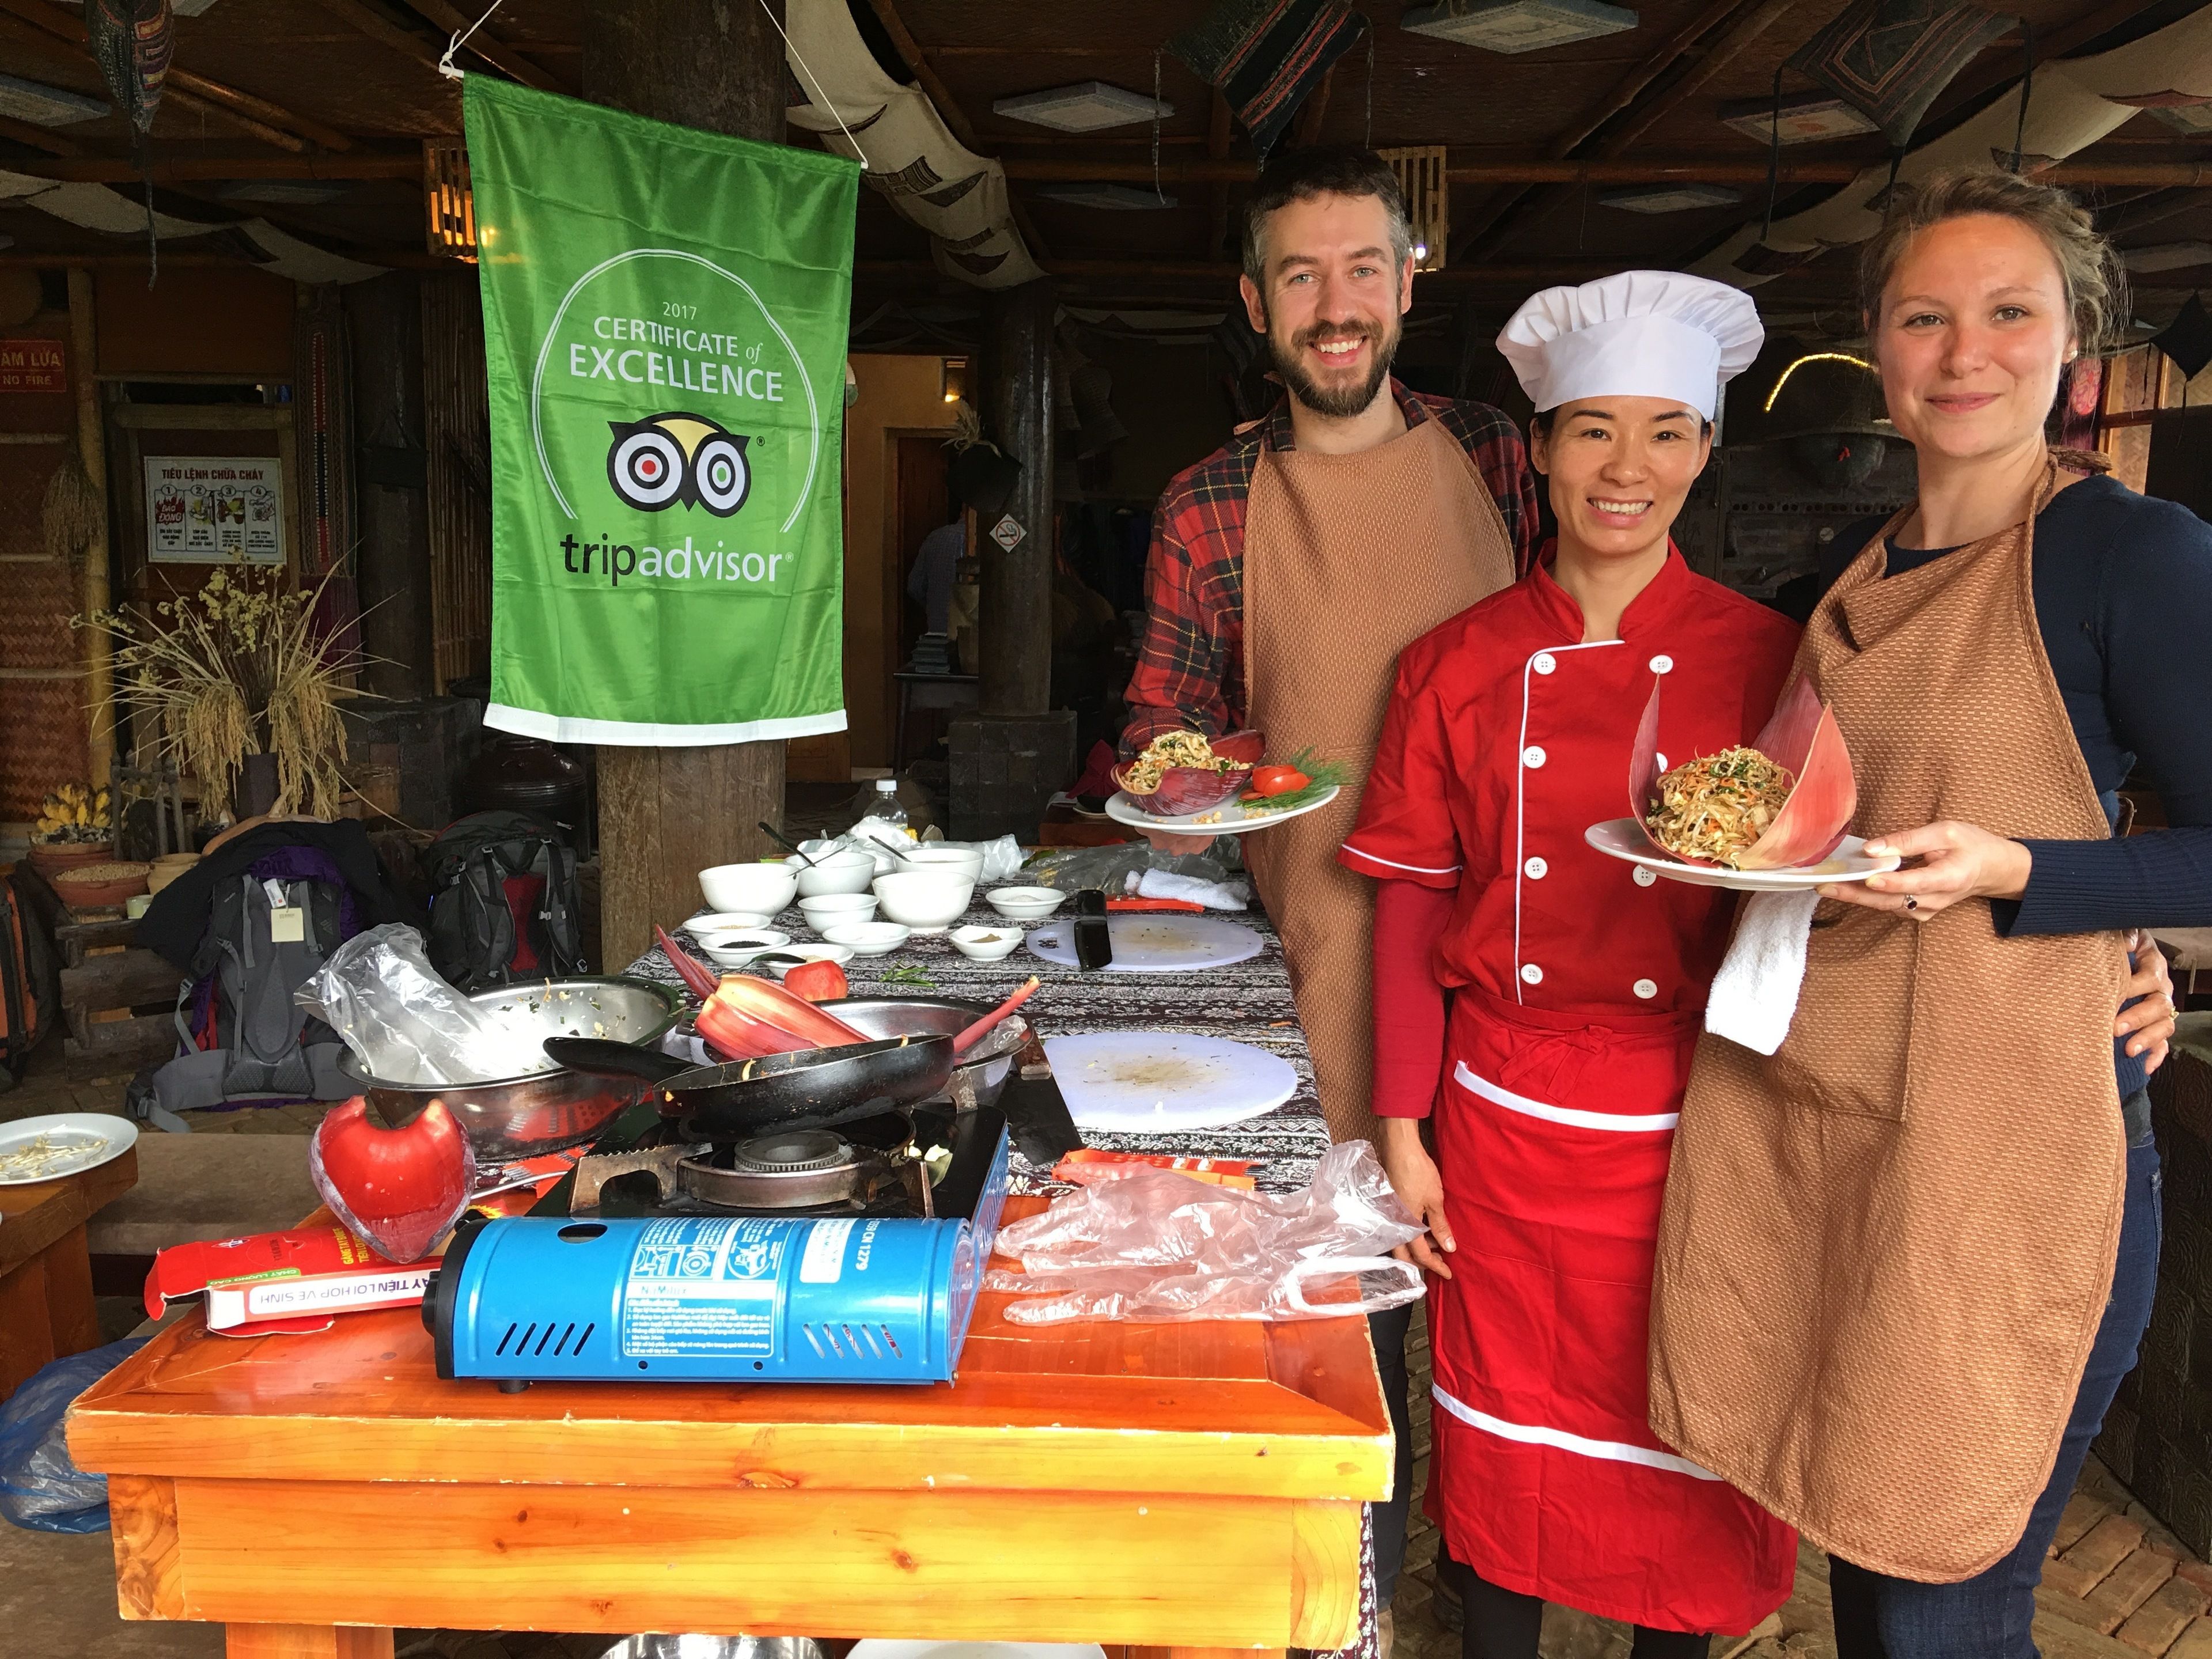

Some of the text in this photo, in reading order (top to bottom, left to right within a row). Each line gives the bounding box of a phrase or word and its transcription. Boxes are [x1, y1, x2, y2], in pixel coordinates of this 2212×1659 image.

[662, 302, 697, 320] 2017
[594, 316, 763, 364] CERTIFICATE of
[3, 374, 52, 385] NO FIRE
[570, 343, 784, 402] EXCELLENCE
[239, 468, 264, 480] CHÁY
[559, 533, 782, 586] tripadvisor
[260, 1293, 294, 1304] SINH
